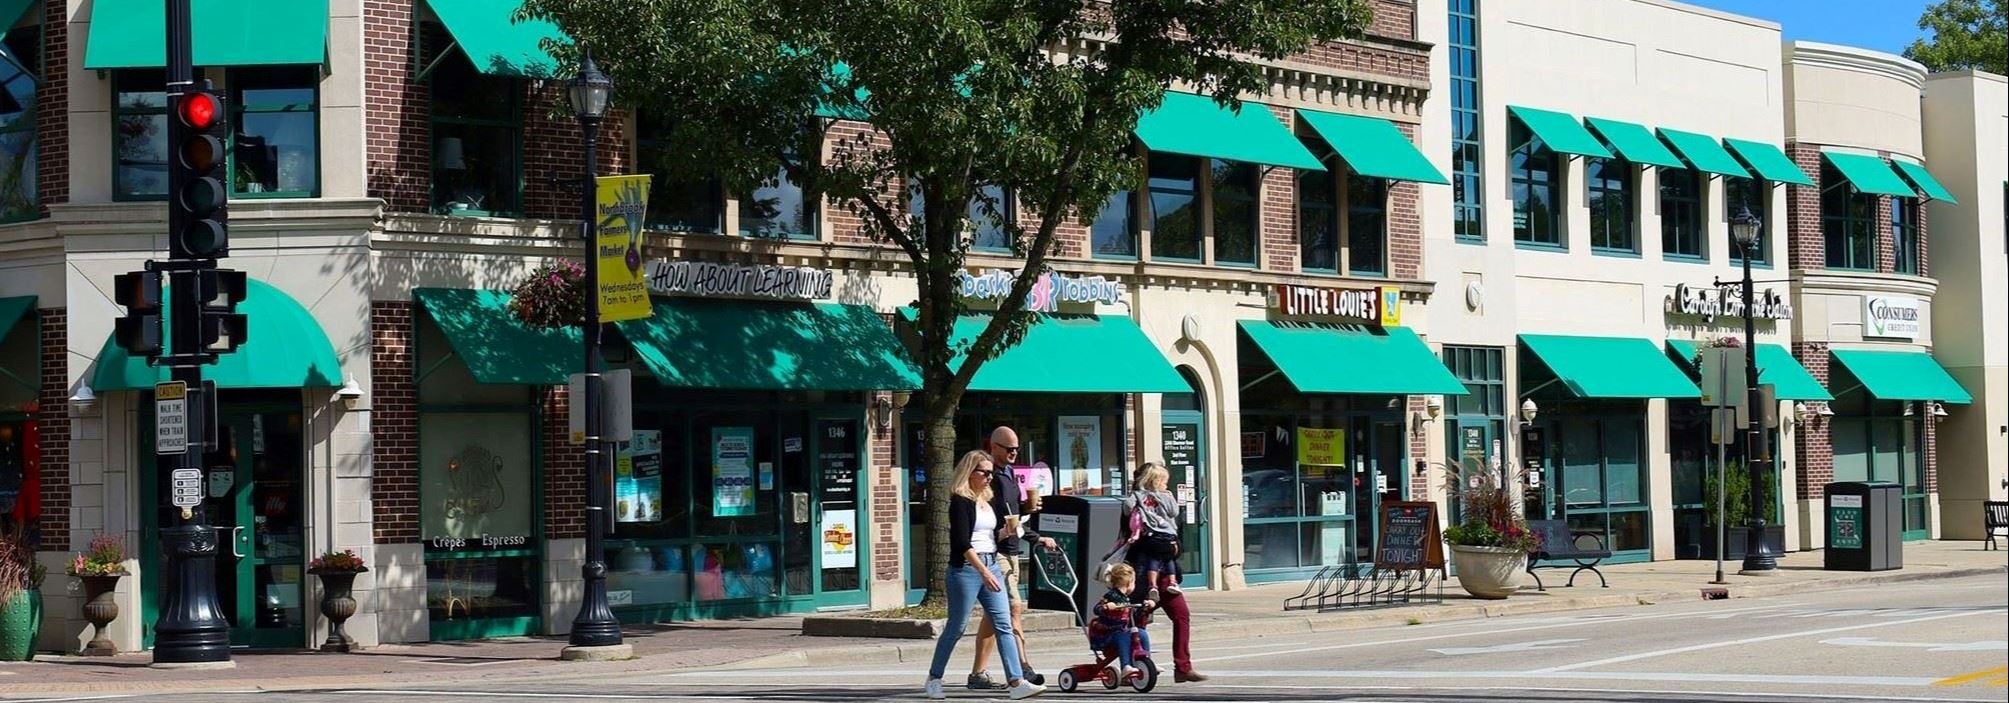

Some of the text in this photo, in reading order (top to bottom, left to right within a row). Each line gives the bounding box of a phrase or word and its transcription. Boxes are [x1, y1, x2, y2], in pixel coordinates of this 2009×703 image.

[599, 201, 645, 215] Northbrook
[600, 224, 627, 236] Farmers
[600, 244, 624, 257] Market
[652, 262, 832, 299] HOW ABOUT LEARNING
[963, 270, 1014, 299] baski
[600, 283, 645, 295] Wednesdays
[602, 294, 645, 306] 7am to 1pm
[1286, 284, 1376, 321] LITTLE LOUIE'S
[1678, 283, 1721, 323] Carolyn
[1765, 288, 1793, 320] Salon
[1876, 305, 1918, 322] CONSUMERS
[160, 385, 183, 397] CAUTION
[160, 403, 183, 414] WALK TIME
[160, 416, 183, 425] SHORTENED
[160, 427, 184, 437] WHEN TRAIN
[828, 427, 846, 438] 1346
[1172, 430, 1187, 440] 1340
[159, 438, 185, 447] APPROACHES
[1309, 443, 1330, 452] DINNER
[265, 497, 286, 513] illy
[482, 533, 525, 549] Espresso
[1386, 535, 1421, 546] DINNER
[1382, 548, 1424, 563] TONIGHT
